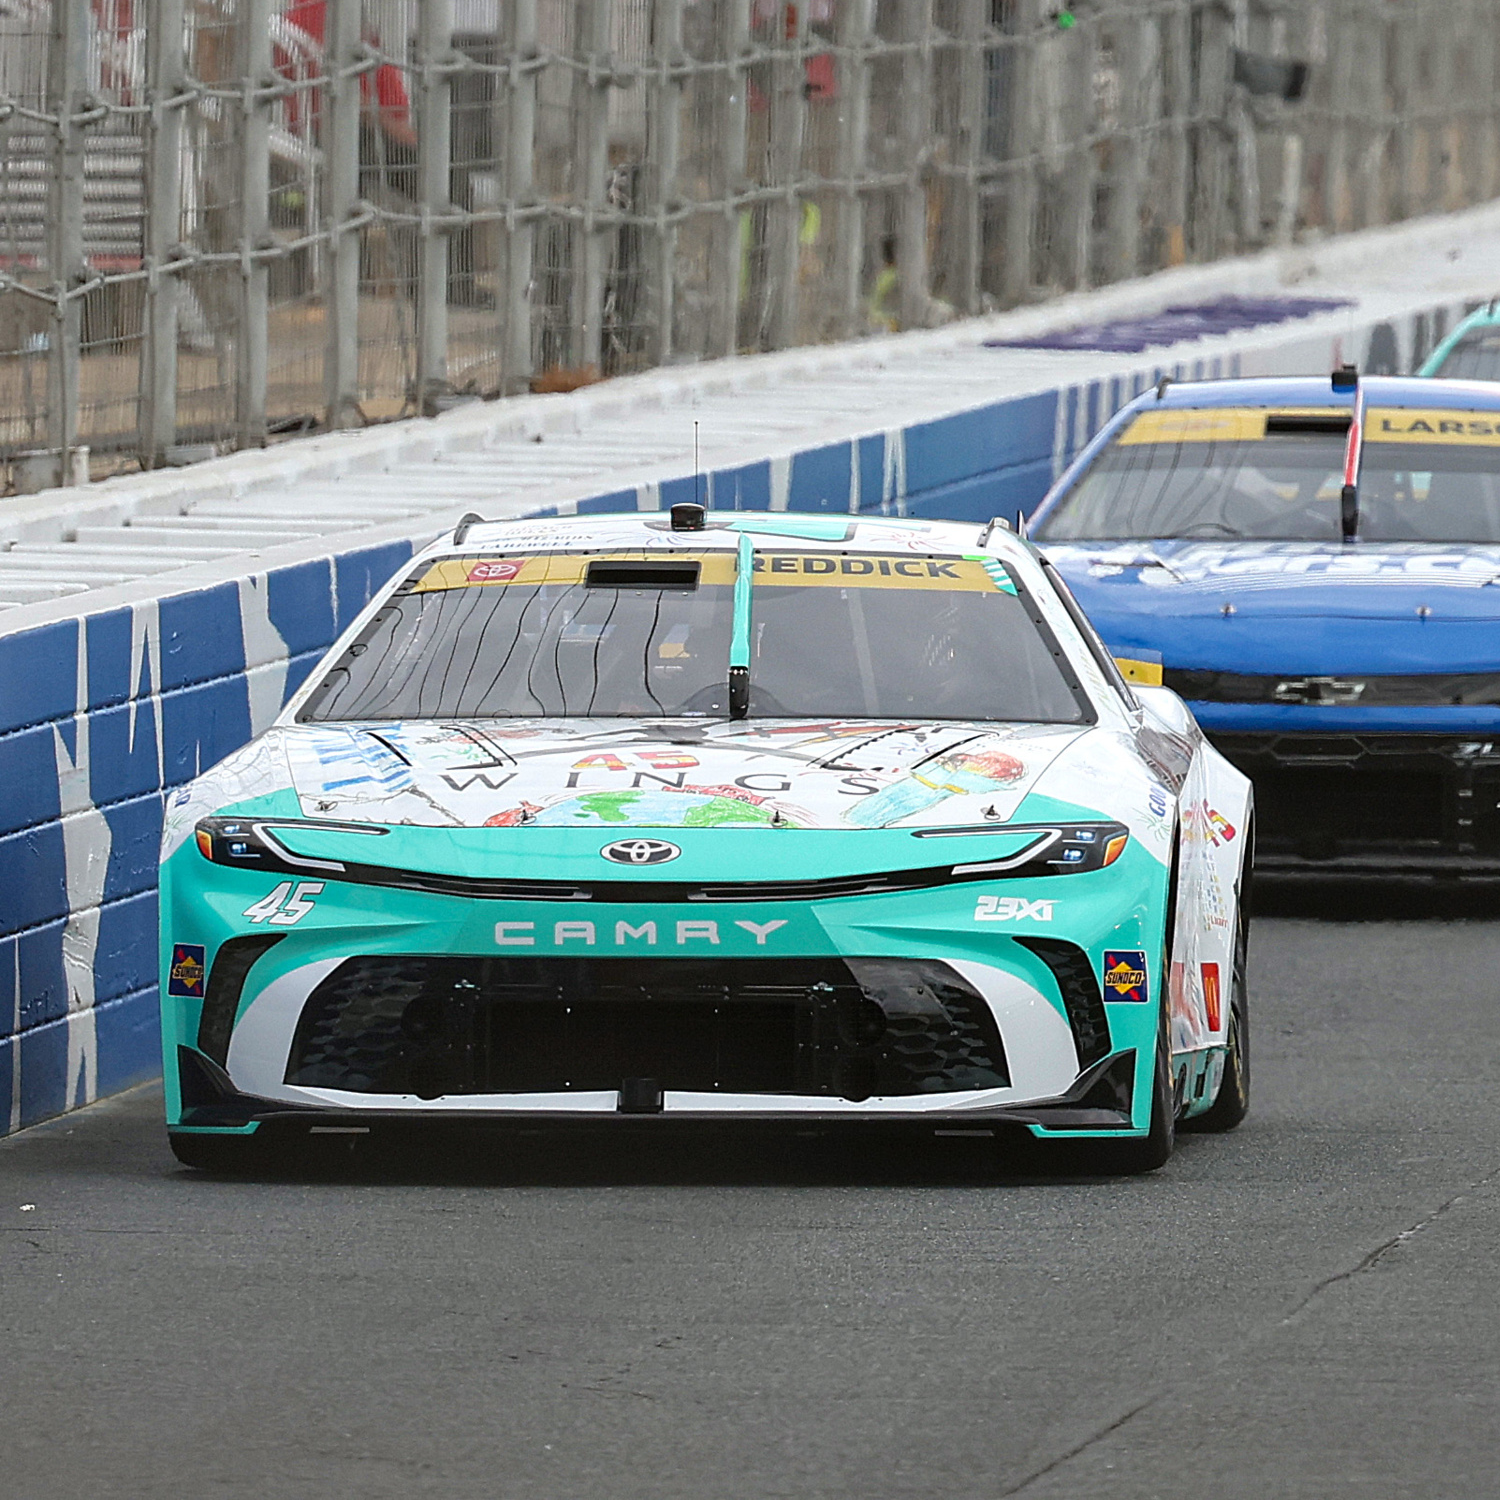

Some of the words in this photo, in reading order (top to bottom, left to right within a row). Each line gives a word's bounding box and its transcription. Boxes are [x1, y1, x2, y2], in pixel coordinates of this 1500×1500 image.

[571, 749, 701, 772] 45
[440, 770, 880, 797] WINGS
[242, 881, 326, 926] 45
[495, 920, 789, 945] CAMRY
[1106, 971, 1144, 985] SUNOCO
